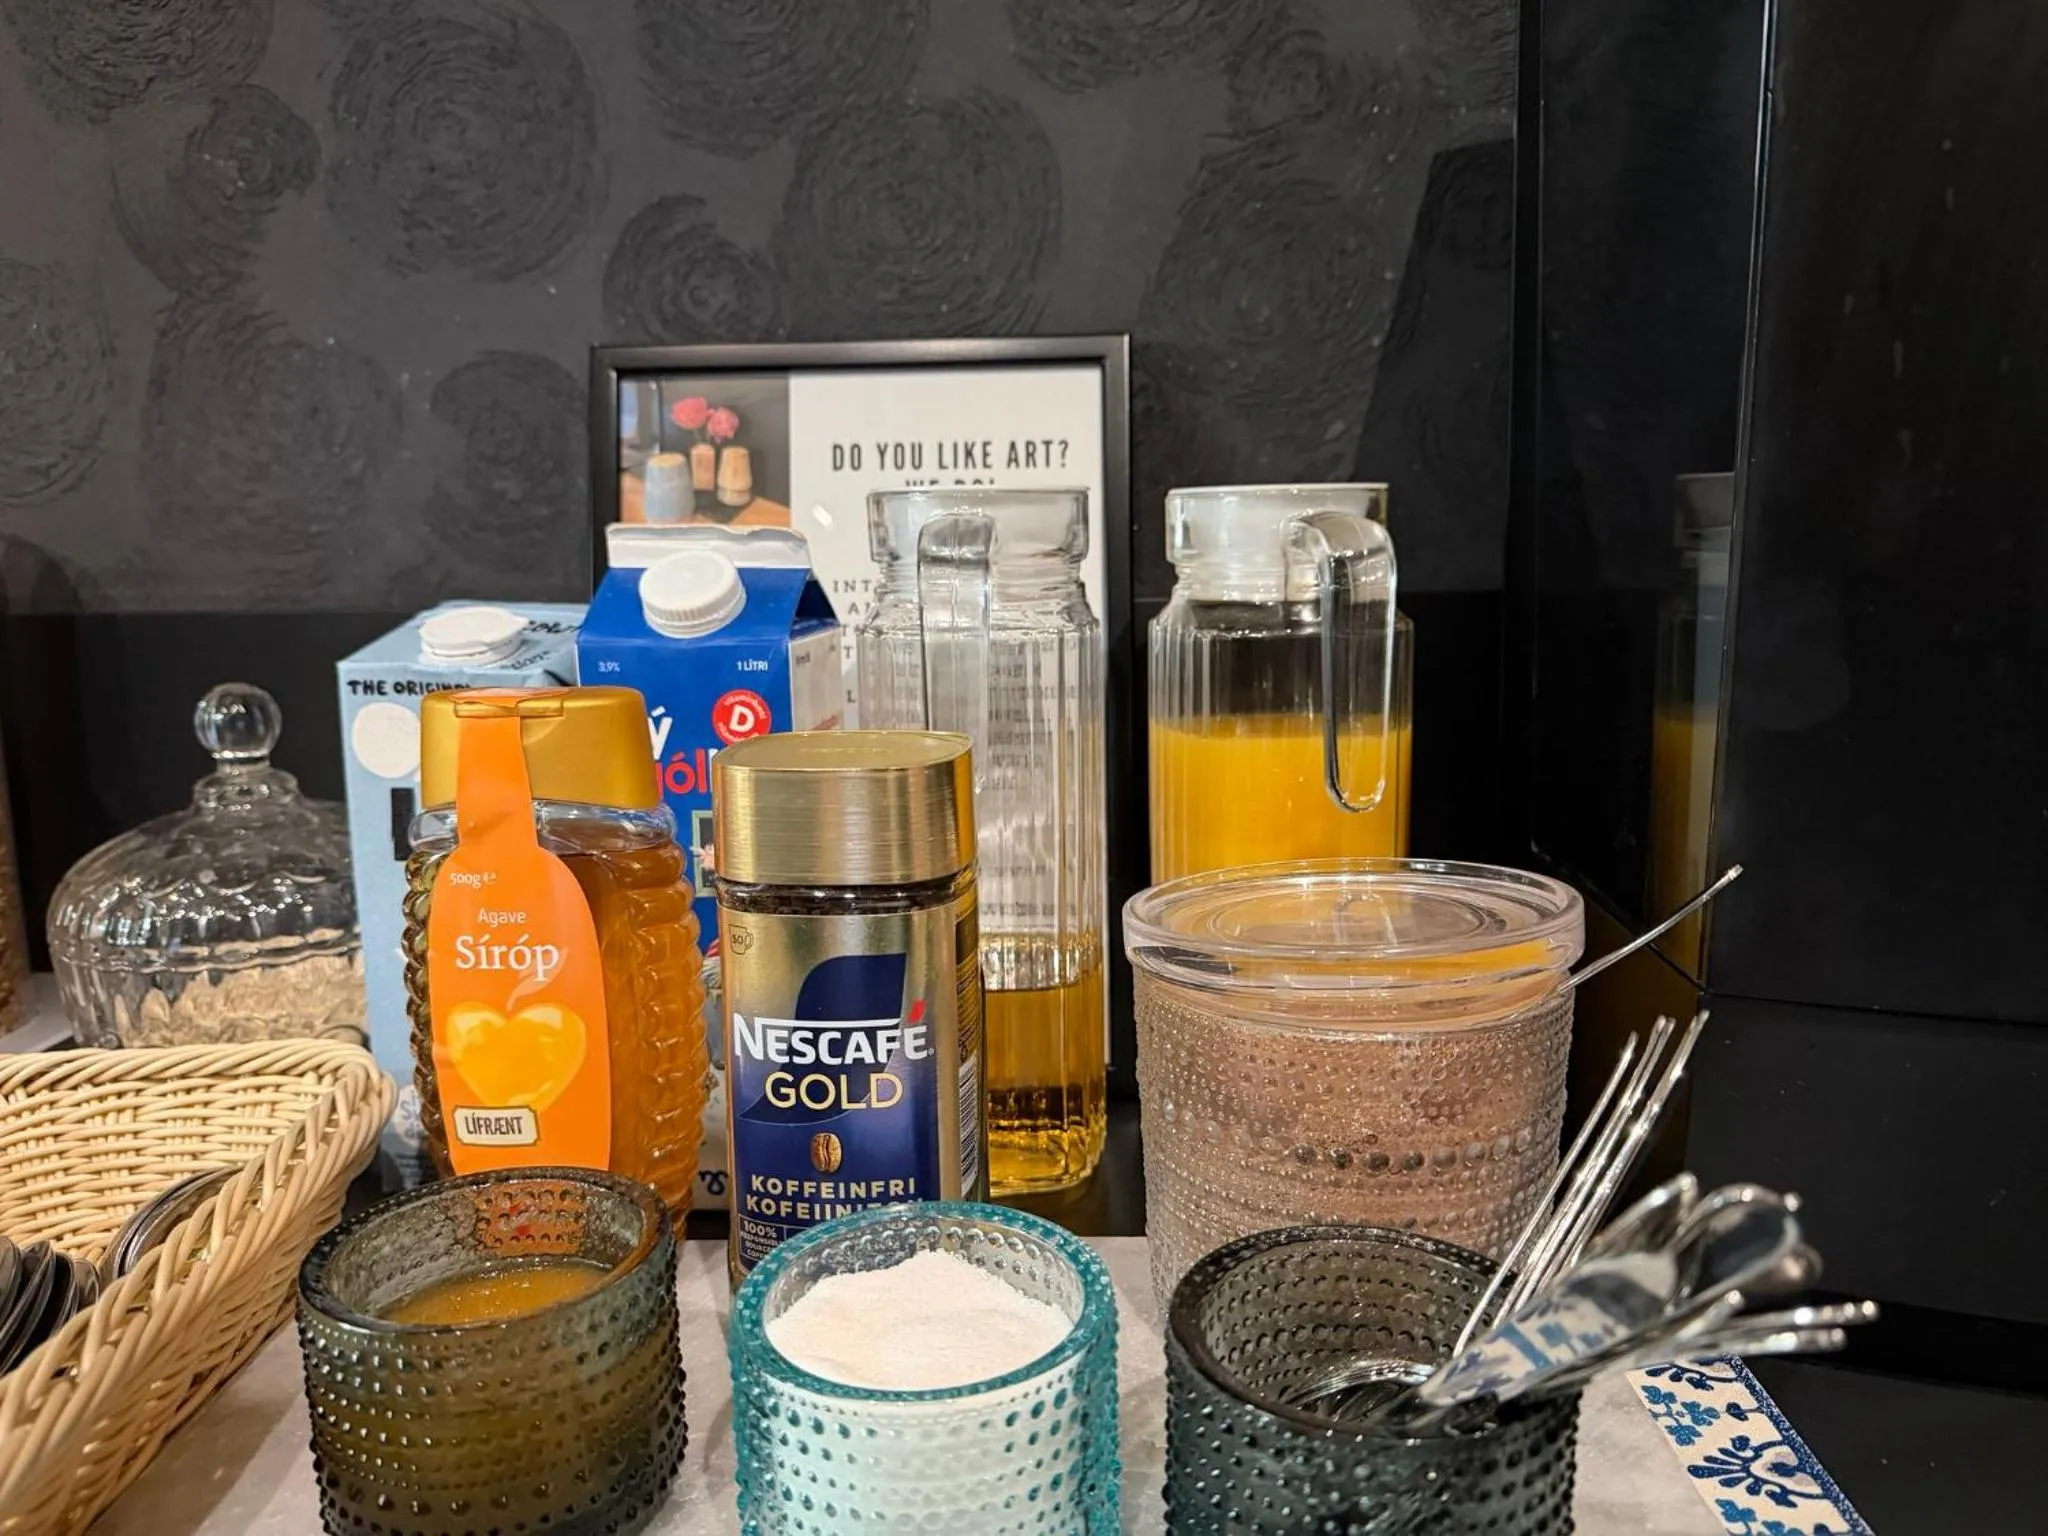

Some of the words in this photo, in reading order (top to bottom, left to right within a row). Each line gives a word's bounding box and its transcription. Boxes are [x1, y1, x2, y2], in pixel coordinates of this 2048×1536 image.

[832, 443, 862, 472] DO
[876, 442, 924, 471] YOU
[937, 440, 994, 470] LIKE
[1006, 439, 1070, 469] ART?
[736, 660, 743, 671] 1
[346, 679, 389, 696] THE
[393, 680, 472, 697] ORIGI
[728, 703, 756, 733] D
[449, 872, 481, 890] 500g
[477, 907, 527, 928] Agave
[454, 933, 560, 983] Síróp
[733, 1000, 928, 1066] NESCAFÉ
[764, 1071, 904, 1110] GOLD
[464, 1114, 524, 1136] LÍFRÆNT
[751, 1173, 917, 1199] KOFFEINFRI
[746, 1194, 923, 1220] KOFEIIN
[743, 1220, 778, 1239] 100%
